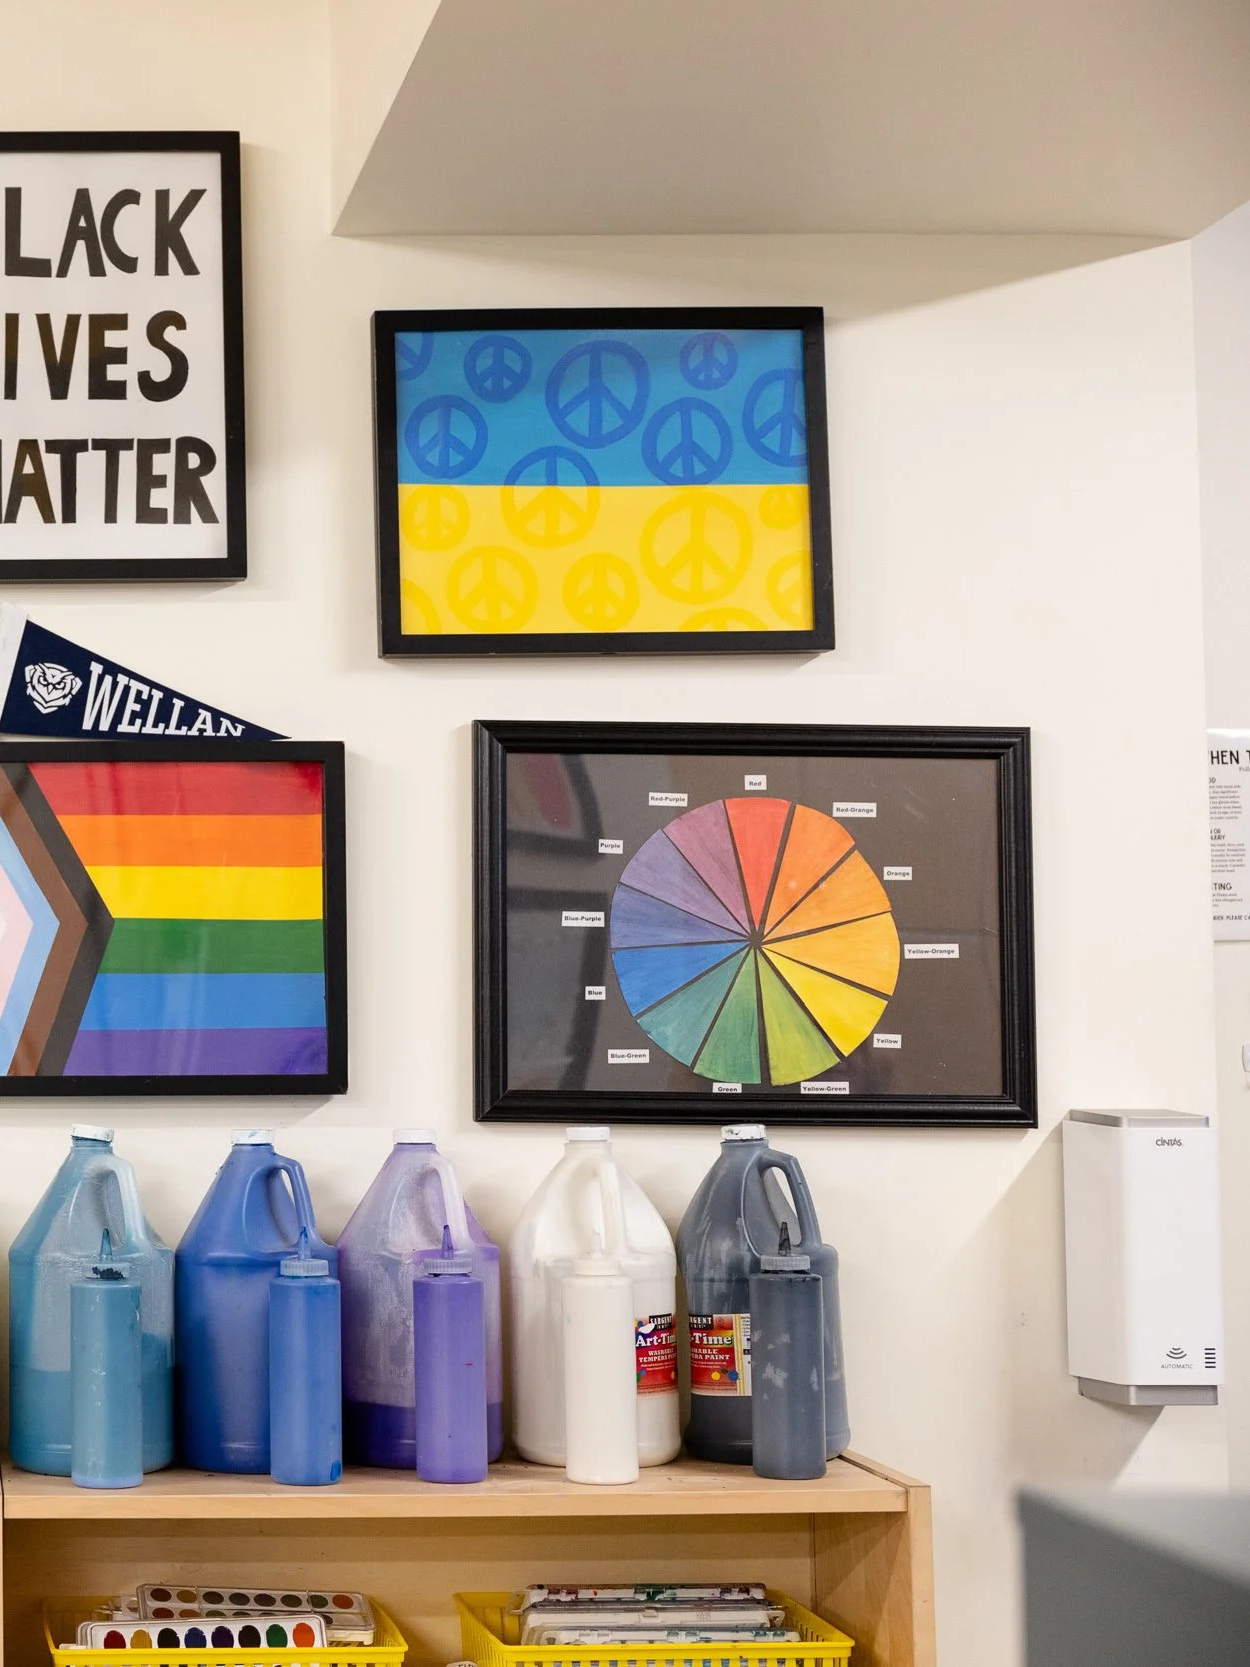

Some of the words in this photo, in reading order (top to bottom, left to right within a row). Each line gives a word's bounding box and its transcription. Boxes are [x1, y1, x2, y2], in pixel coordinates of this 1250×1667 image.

[81, 660, 246, 737] WELLAN
[1208, 750, 1240, 765] HEN
[650, 795, 686, 803] Red-Purple
[835, 806, 874, 814] Red-Orange
[600, 842, 621, 850] Purple
[885, 870, 911, 878] Orange
[1212, 882, 1232, 891] TING
[564, 915, 602, 923] Blue-Purple
[907, 947, 955, 955] Yellow-Orange
[876, 1037, 899, 1045] Yellow
[717, 1085, 738, 1093] Green
[802, 1085, 847, 1093] Yellow-Green
